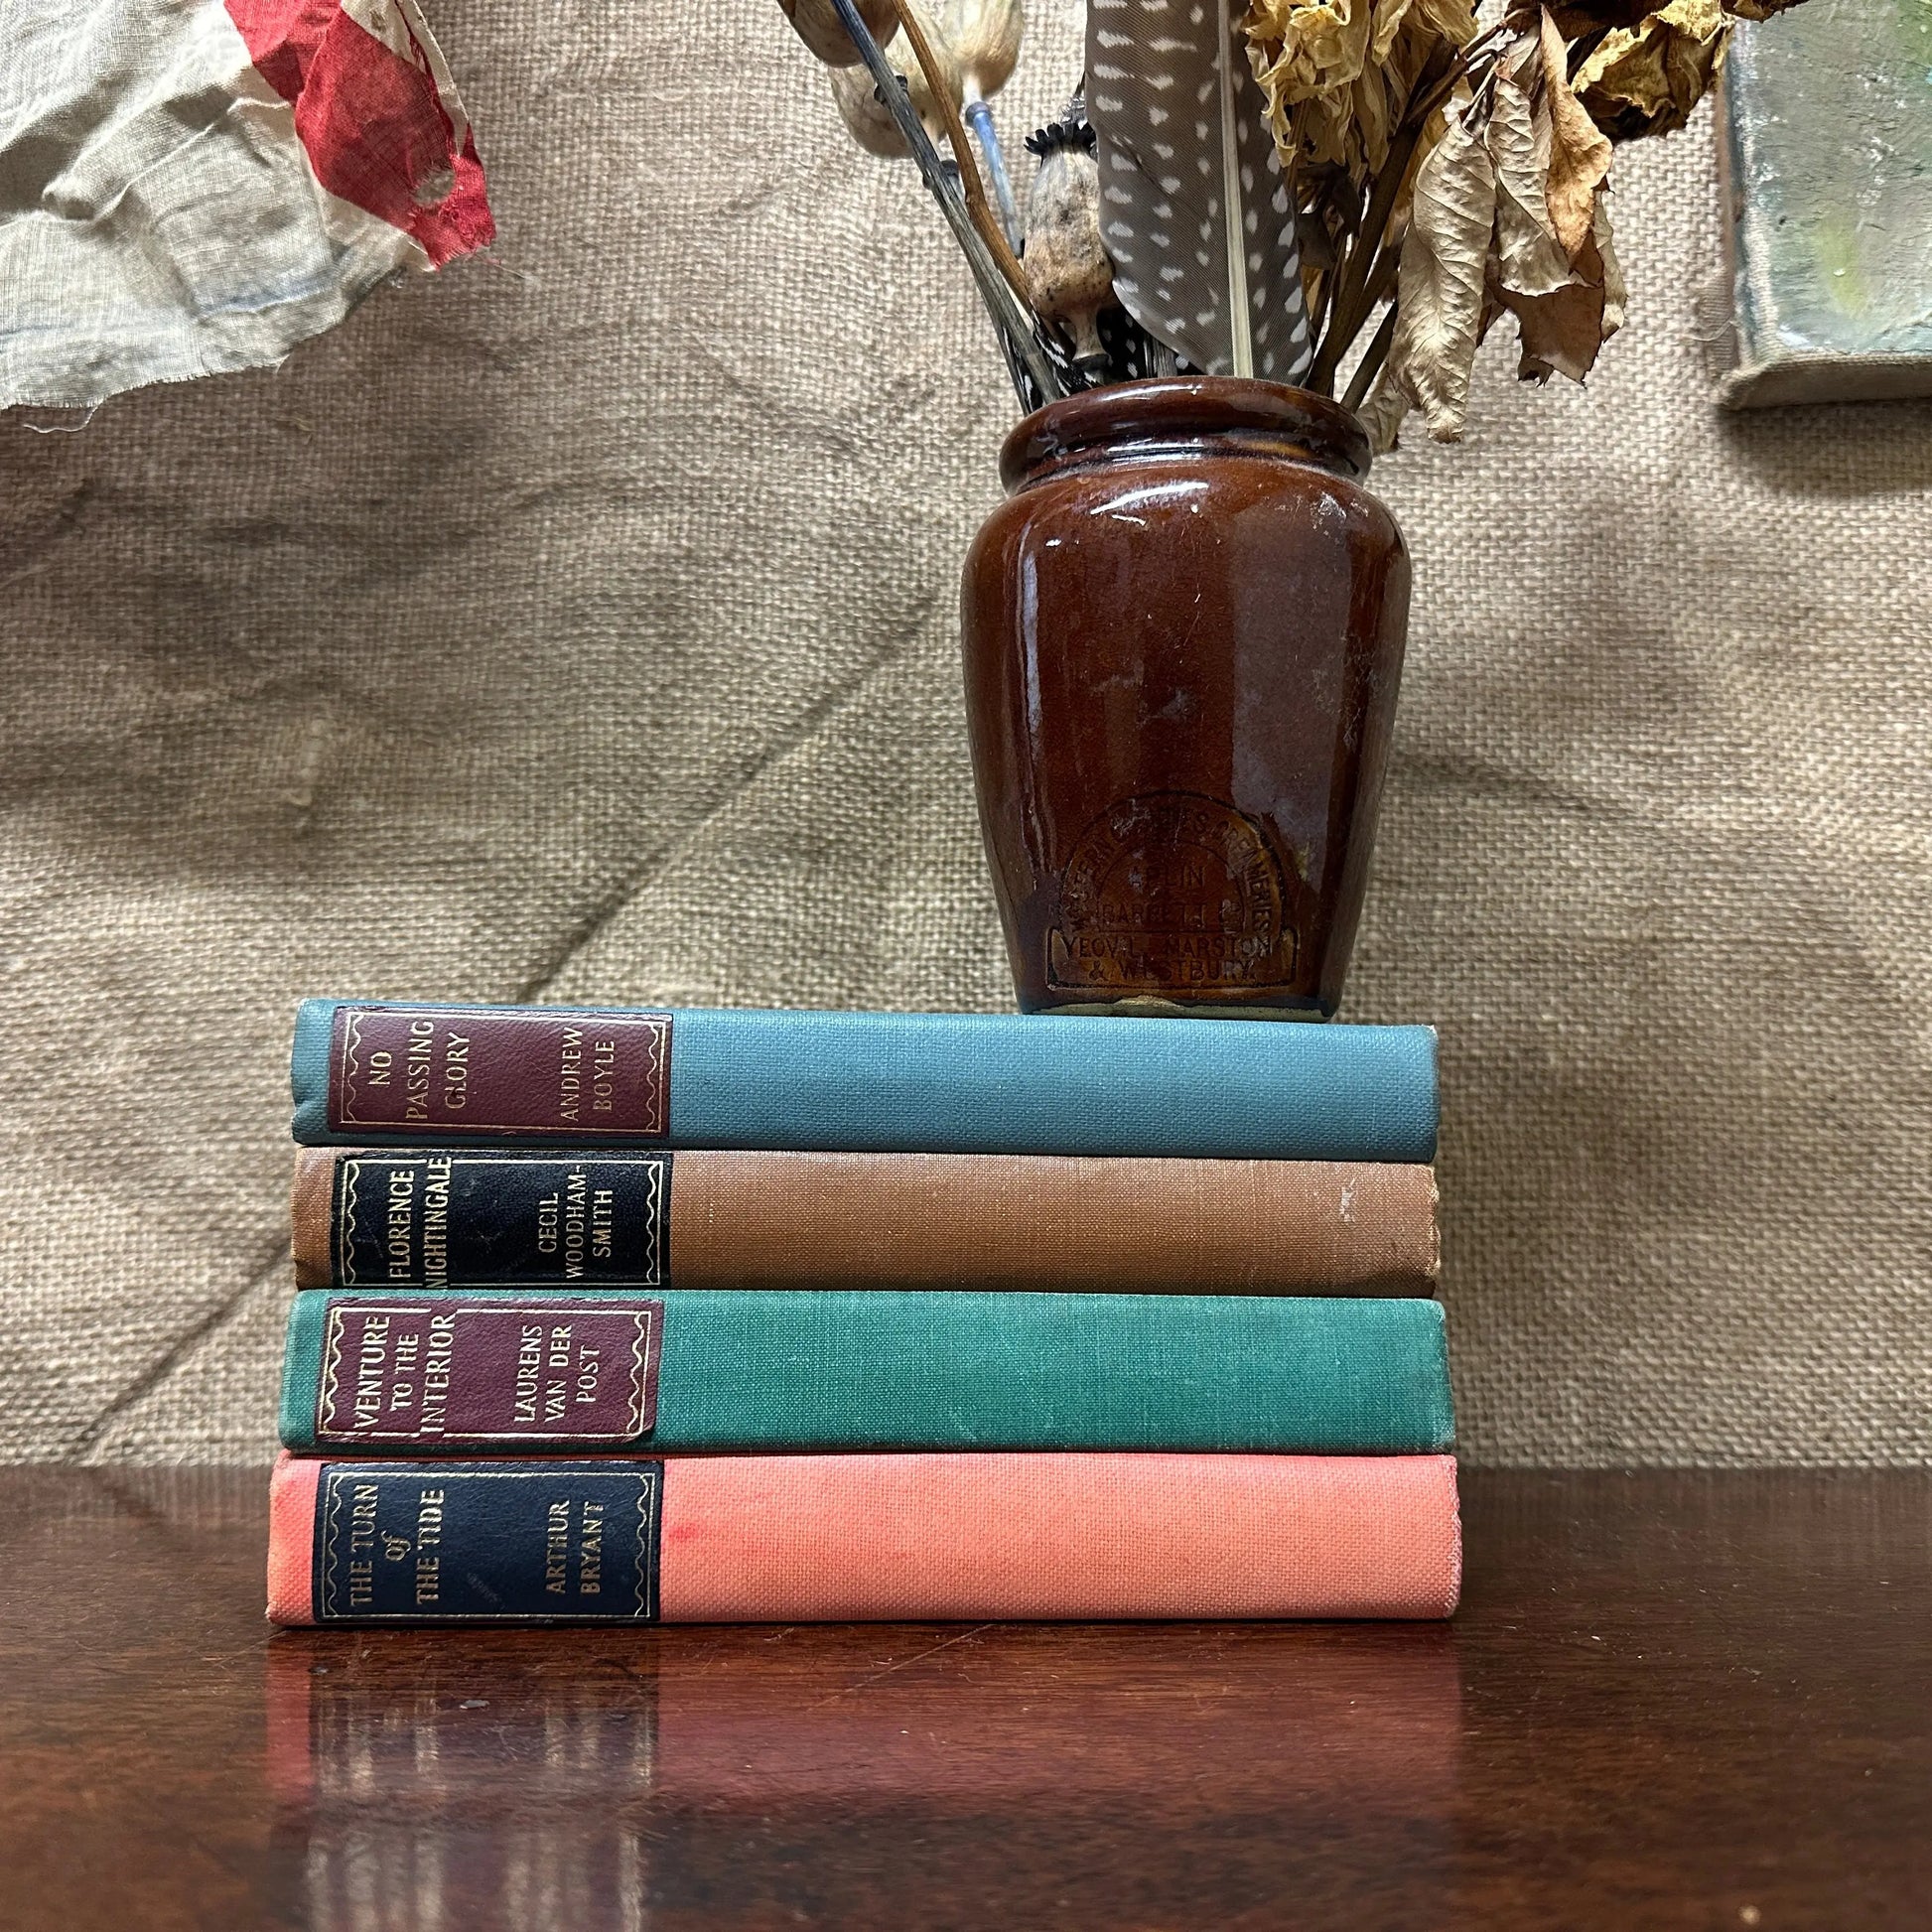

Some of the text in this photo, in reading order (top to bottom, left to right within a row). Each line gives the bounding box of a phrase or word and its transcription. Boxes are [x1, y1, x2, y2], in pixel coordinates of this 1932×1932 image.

[1088, 959, 1107, 981] &
[1160, 935, 1273, 959] MARSTON
[368, 1050, 392, 1087] NO
[405, 1020, 435, 1120] PASSING
[444, 1032, 471, 1110] GLORY
[560, 1027, 584, 1122] ANDREW
[592, 1039, 616, 1112] BOYLE
[387, 1169, 415, 1279] FLORENCE
[423, 1156, 452, 1288] NIGHTINGALE
[538, 1191, 559, 1254] CECIL
[565, 1165, 587, 1280] WOODHAM-
[592, 1189, 614, 1259] SMITH
[353, 1314, 391, 1429] VENTURE
[390, 1333, 419, 1412] TO THE
[420, 1312, 457, 1433] INTERIOR
[514, 1324, 544, 1423] LAURENS
[545, 1324, 573, 1423] VAN DER
[576, 1344, 600, 1404] POST
[350, 1484, 379, 1606] THE TURN
[381, 1530, 411, 1562] of
[416, 1488, 445, 1605] THE TIDE
[546, 1499, 570, 1594] ARTHUR
[580, 1501, 606, 1596] BRYANT
